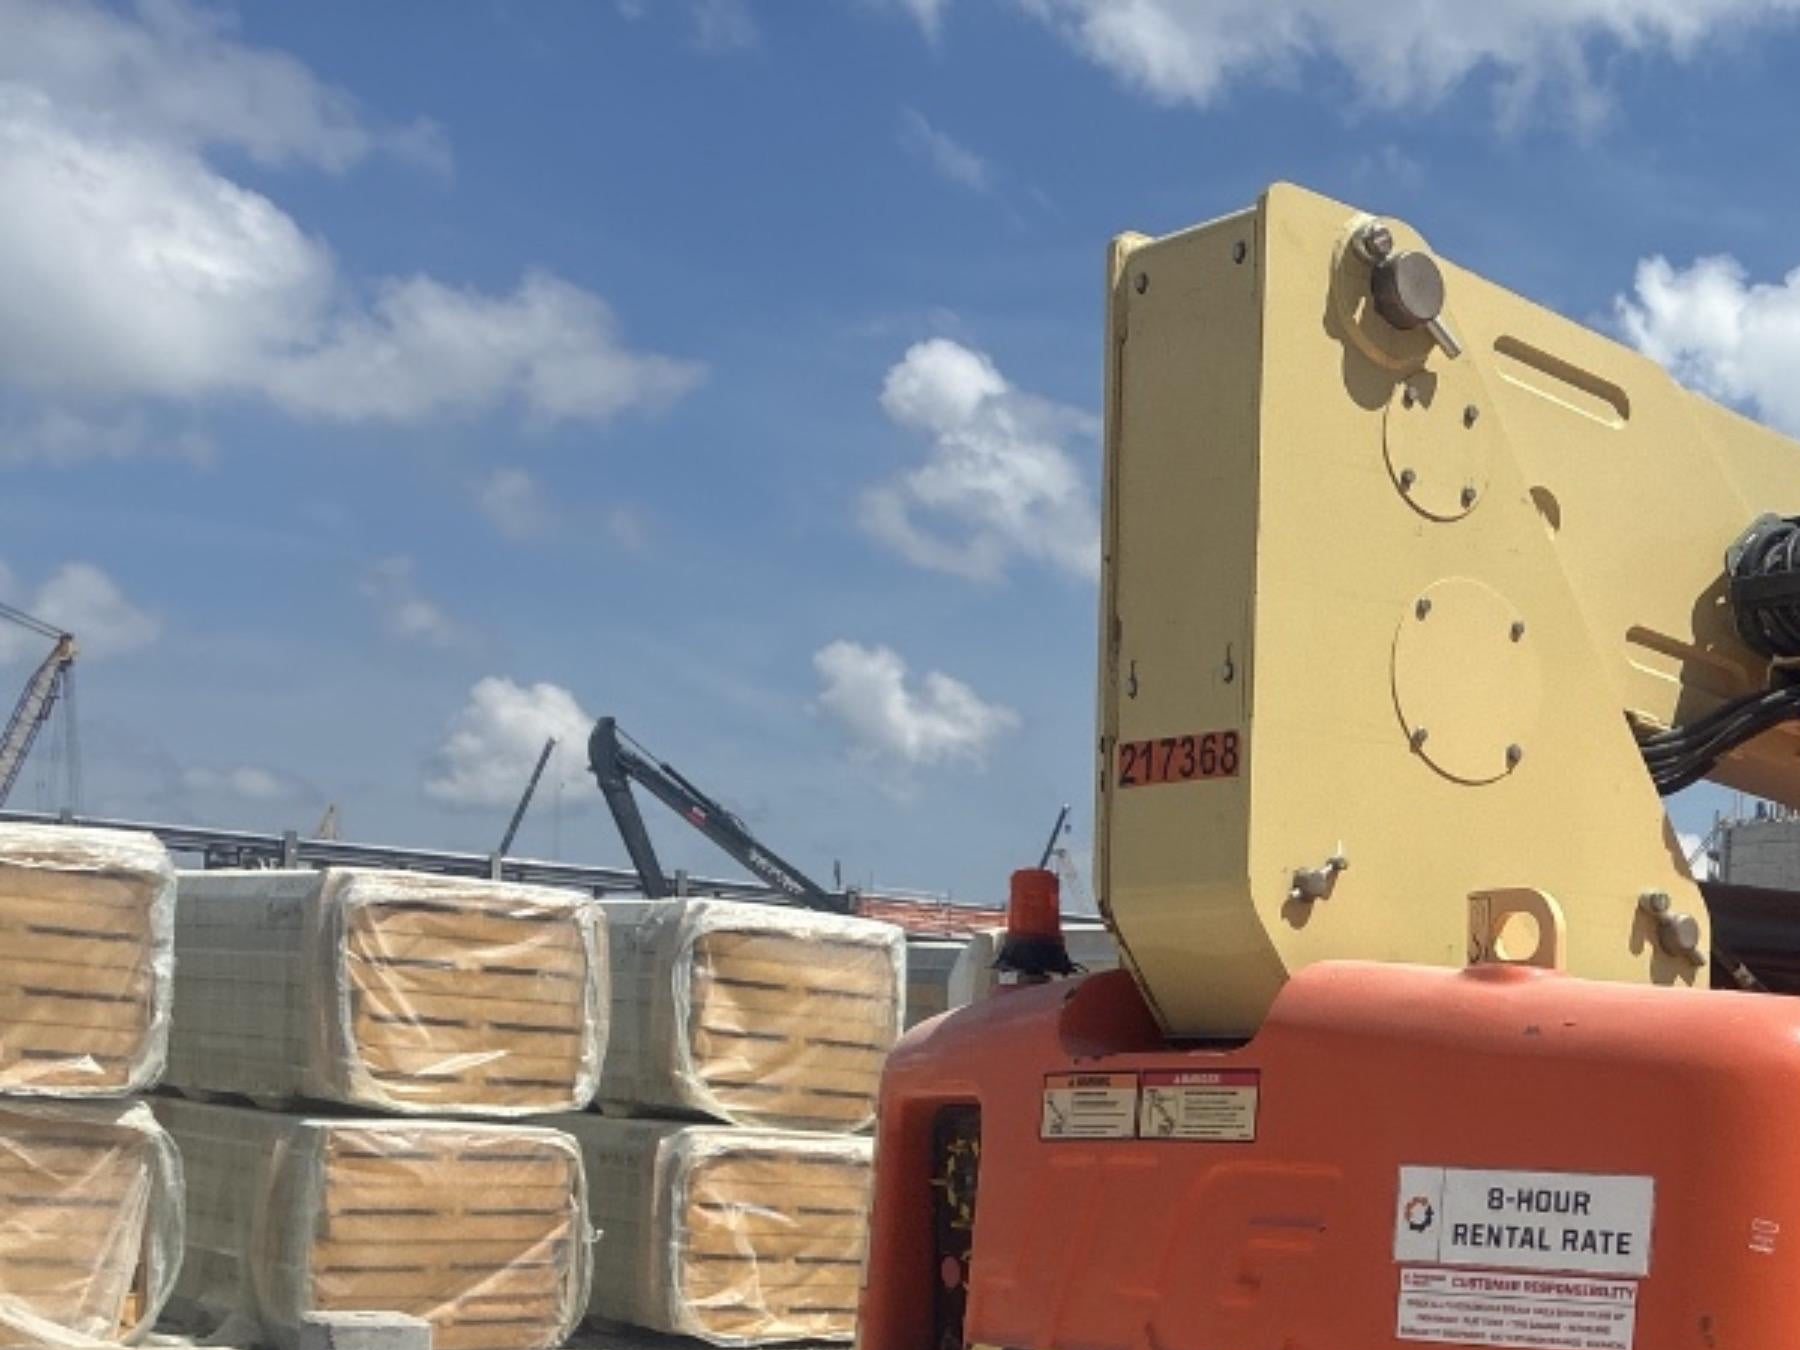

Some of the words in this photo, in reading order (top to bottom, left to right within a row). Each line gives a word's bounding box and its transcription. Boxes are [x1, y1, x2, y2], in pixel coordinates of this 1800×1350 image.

[1119, 731, 1239, 784] 217368
[1487, 1187, 1591, 1215] 8-HOUR
[1451, 1223, 1551, 1251] RENTAL
[1561, 1229, 1633, 1255] RATE
